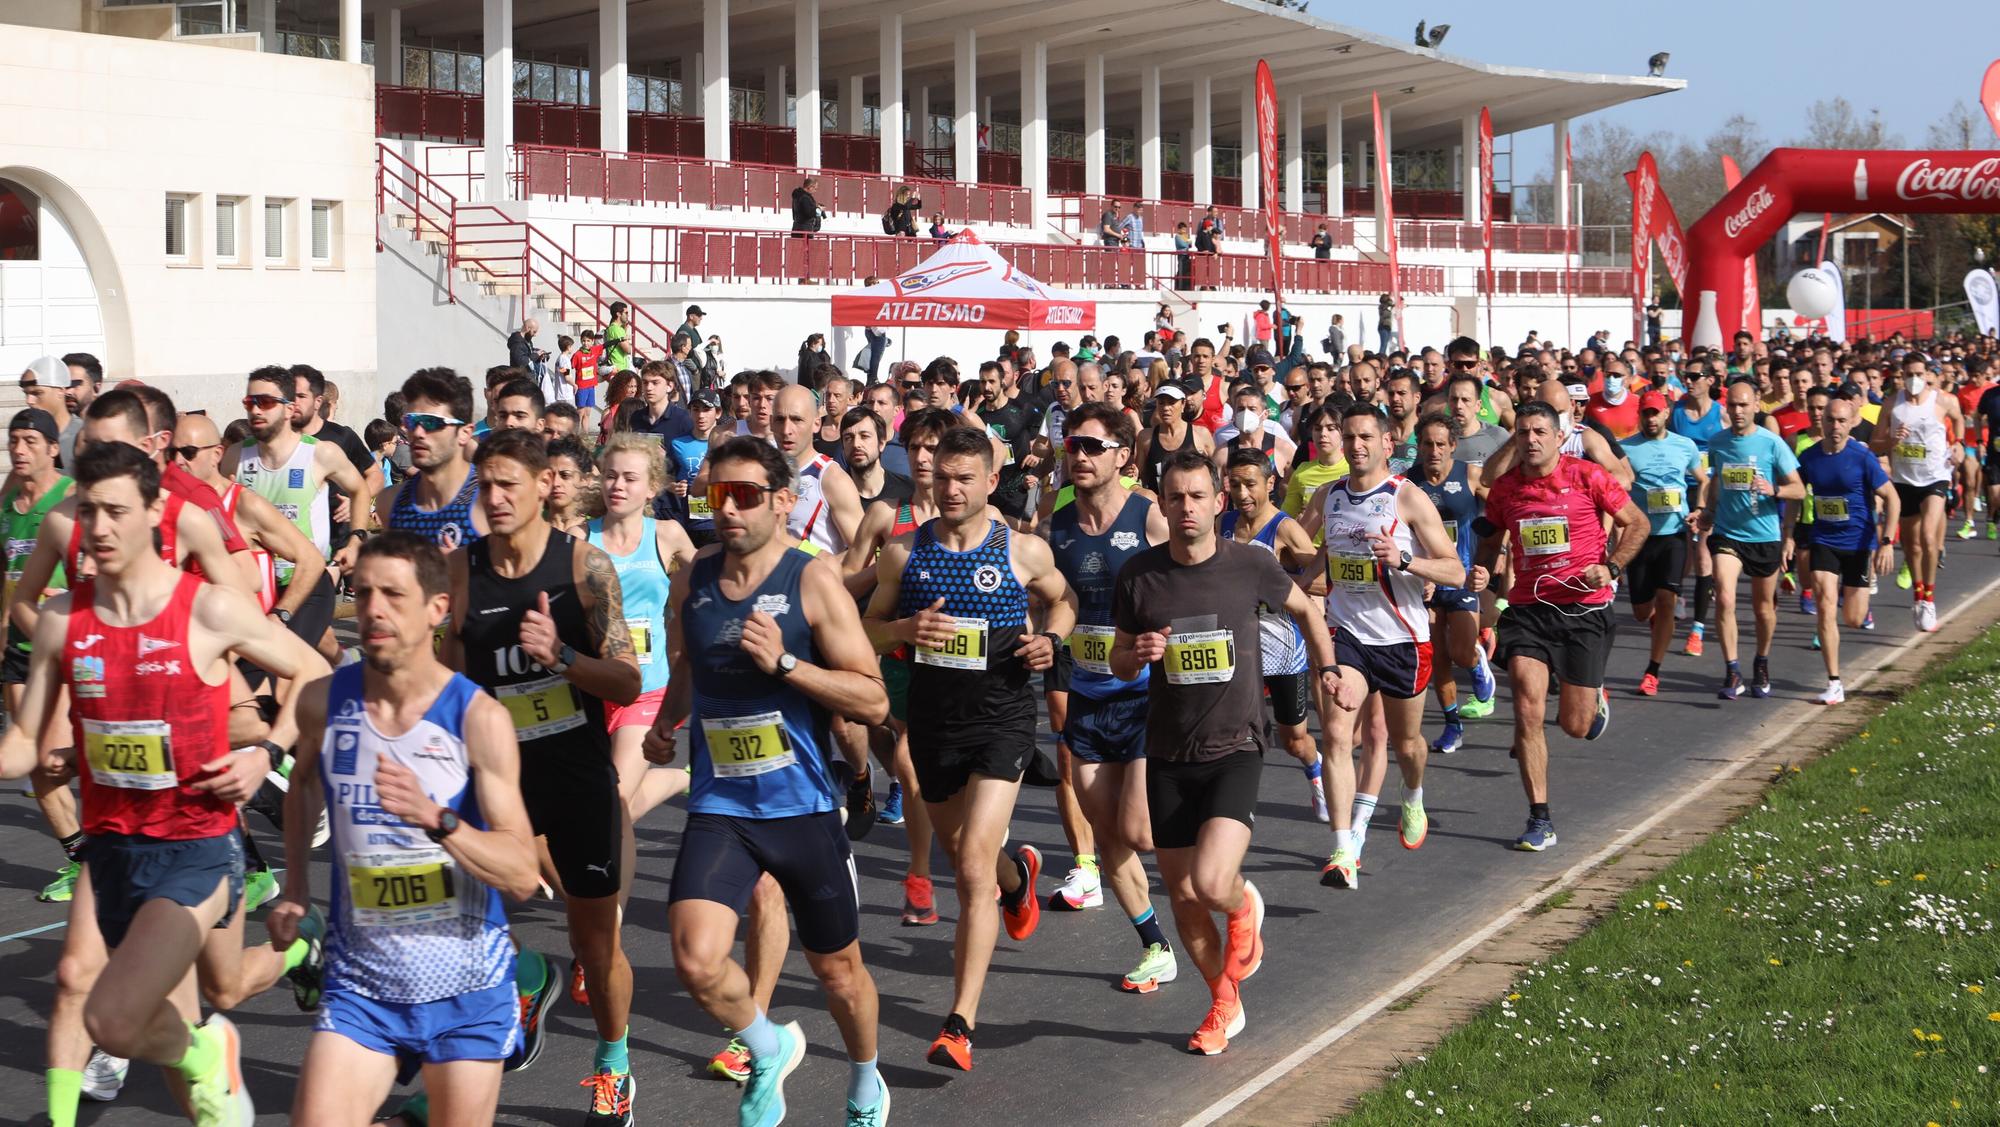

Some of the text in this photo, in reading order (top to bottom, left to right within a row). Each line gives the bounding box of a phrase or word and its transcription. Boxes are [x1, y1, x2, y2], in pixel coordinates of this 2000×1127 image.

[1634, 167, 1656, 269] Coca-Cola
[1724, 184, 1776, 238] Coca-Cola
[876, 302, 985, 323] ATLETISMO
[1045, 305, 1085, 325] ATLETISMO
[1532, 529, 1557, 545] 503
[1340, 563, 1364, 581] 259
[1084, 640, 1106, 661] 313
[1178, 634, 1188, 644] 10
[1180, 648, 1218, 671] 896
[533, 698, 549, 722] 5
[104, 743, 148, 771] 223
[729, 735, 766, 761] 312
[373, 874, 428, 907] 206
